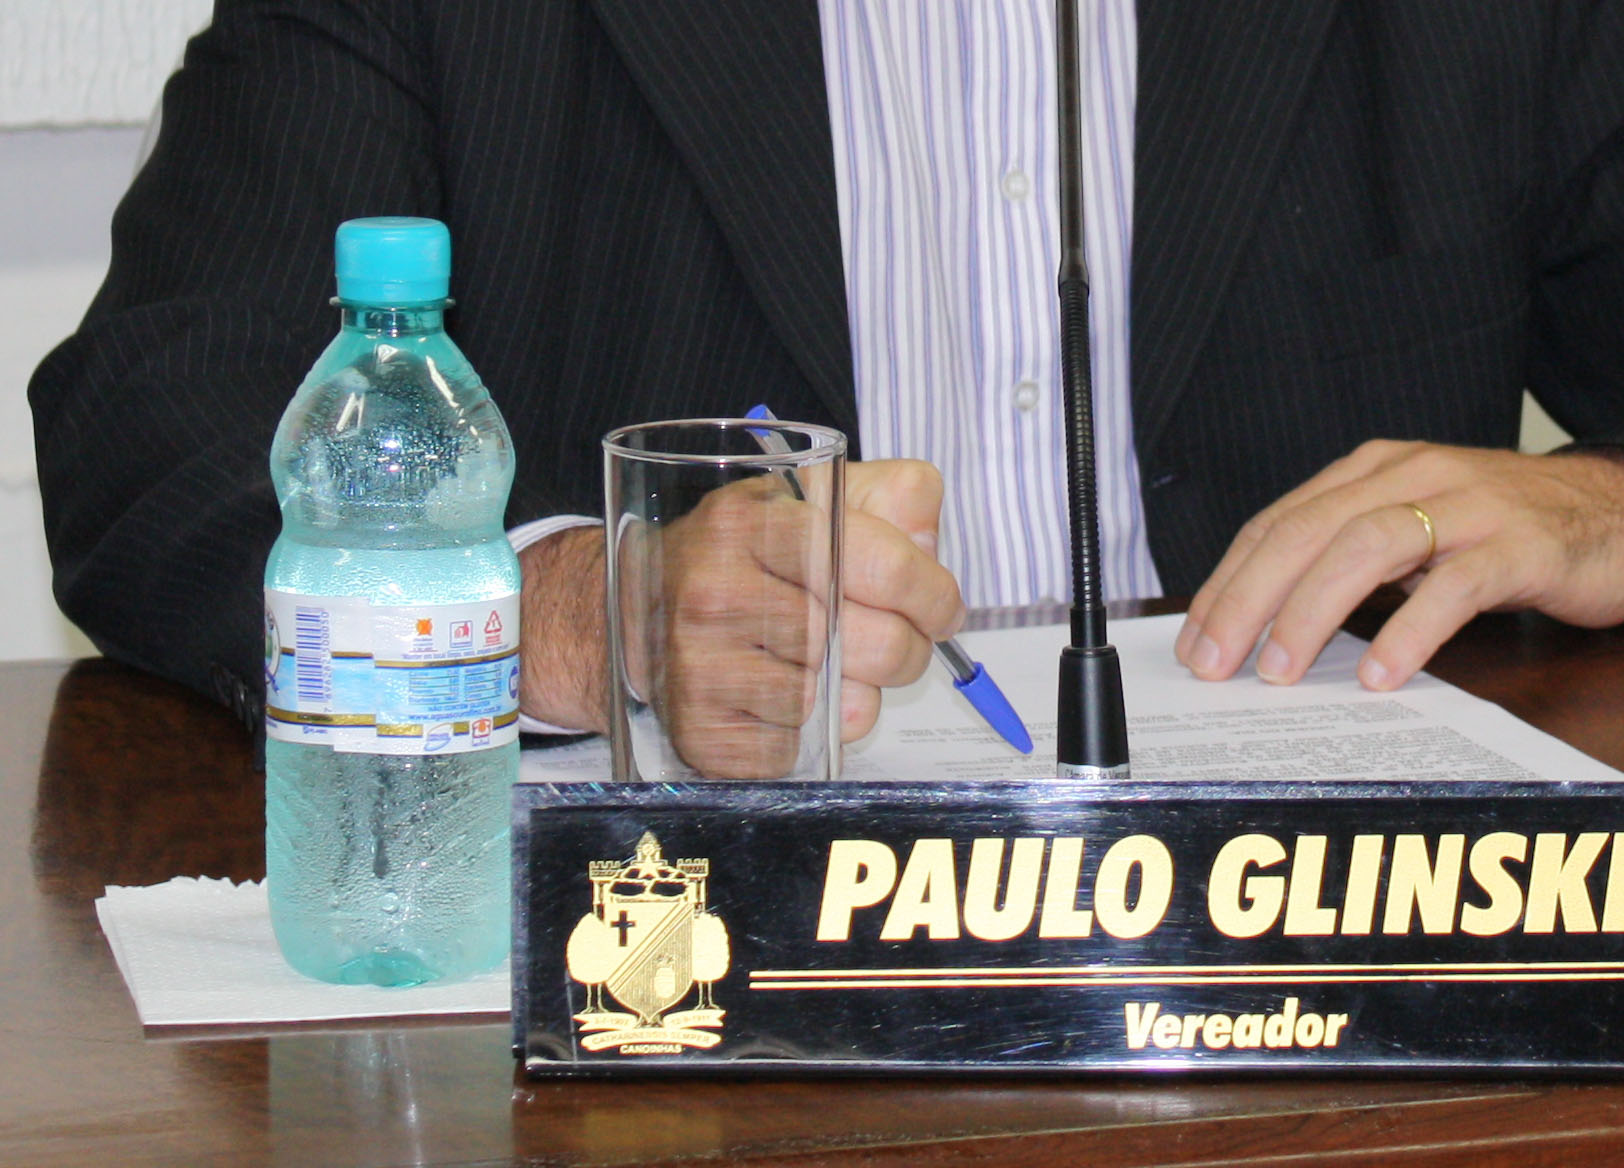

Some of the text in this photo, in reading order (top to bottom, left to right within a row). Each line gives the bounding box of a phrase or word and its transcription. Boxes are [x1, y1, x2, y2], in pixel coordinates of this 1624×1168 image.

[816, 835, 1173, 942] PAULO
[620, 1044, 683, 1054] CANOINHAS
[1123, 998, 1349, 1051] Vereador
